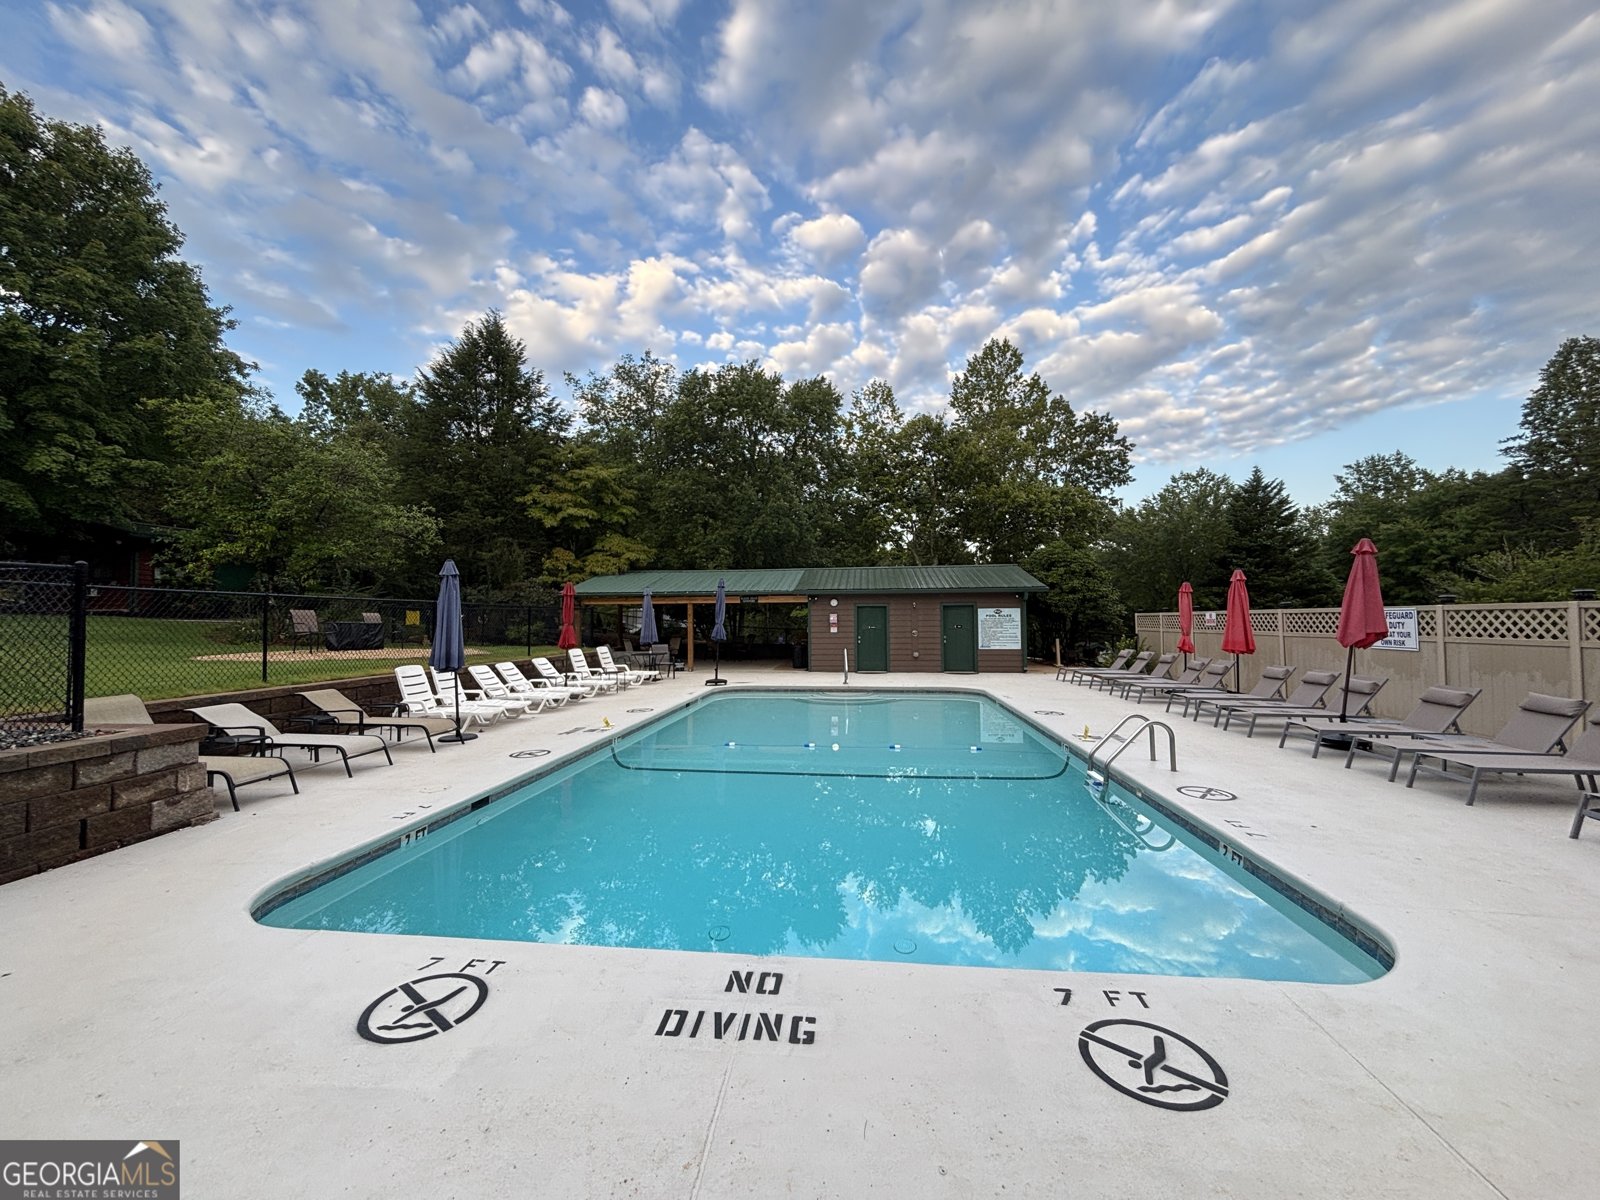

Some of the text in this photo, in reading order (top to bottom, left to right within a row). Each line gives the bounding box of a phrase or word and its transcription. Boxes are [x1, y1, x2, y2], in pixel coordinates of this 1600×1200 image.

[1385, 612, 1414, 620] FEGUARD
[405, 826, 427, 845] 7 FT
[1223, 844, 1242, 866] 7 FT
[417, 956, 507, 975] 7 FT
[724, 970, 784, 996] NO
[1052, 987, 1150, 1009] 7 FT
[654, 1009, 817, 1045] DIVING
